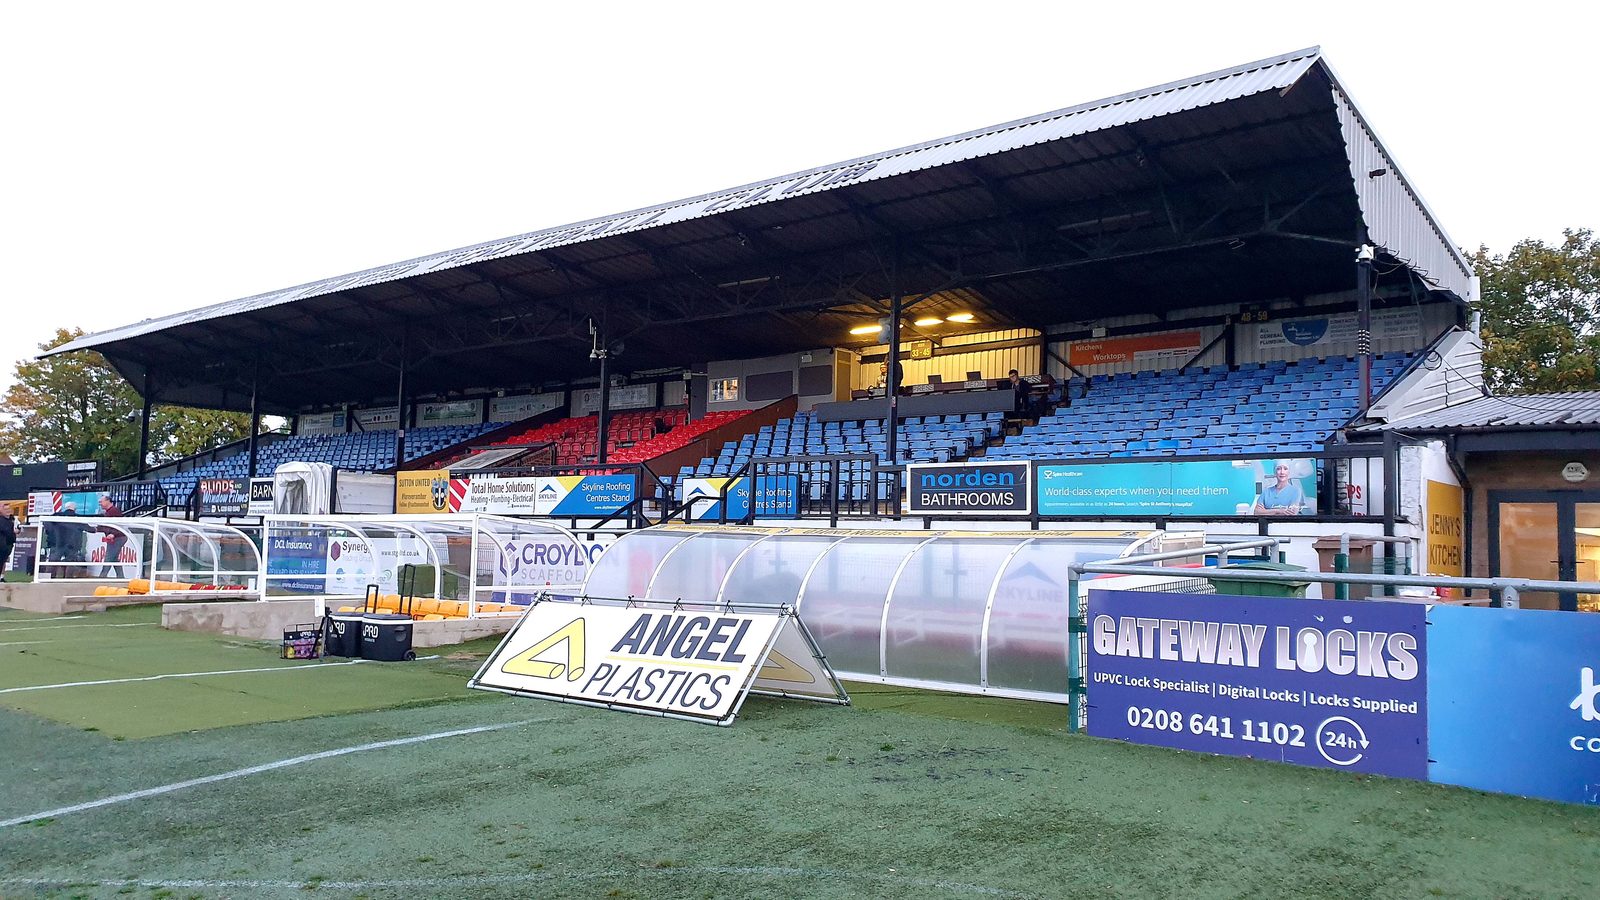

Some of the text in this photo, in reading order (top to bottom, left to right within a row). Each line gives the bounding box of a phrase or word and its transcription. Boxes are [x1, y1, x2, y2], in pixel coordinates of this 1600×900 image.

[703, 163, 878, 212] CLUB
[1093, 353, 1126, 361] Worktops
[399, 478, 430, 487] SUTTON UNITED
[921, 469, 1014, 487] norden
[201, 480, 234, 492] BLINDS
[471, 481, 534, 493] Total Home Solutions
[581, 482, 630, 493] Skyline Roofing
[737, 488, 762, 498] Skyne
[1045, 486, 1229, 497] World-class experts when you need them
[202, 489, 249, 504] Window Films
[470, 494, 534, 505] Heating Plumbing Electrical
[586, 494, 630, 502] Centres Stand
[921, 492, 1014, 506] BATHROOMS
[742, 500, 769, 508] Ctres
[1430, 513, 1461, 537] JENNY'S
[275, 540, 313, 550] DCL Insurance
[342, 541, 370, 553] Synerg
[522, 543, 611, 566] CROYDO
[1430, 544, 1461, 566] KITCHEN
[521, 568, 586, 582] SCAFFOL
[610, 613, 752, 663] ANGEL
[1093, 614, 1419, 681] GATEWAY LOCKS
[581, 663, 731, 710] PLASTICS
[1093, 672, 1418, 715] UPVC Lock Specialist Digital Locks Locks Supplied
[1127, 705, 1306, 748] 0208 641 1102
[1325, 731, 1357, 750] 24h
